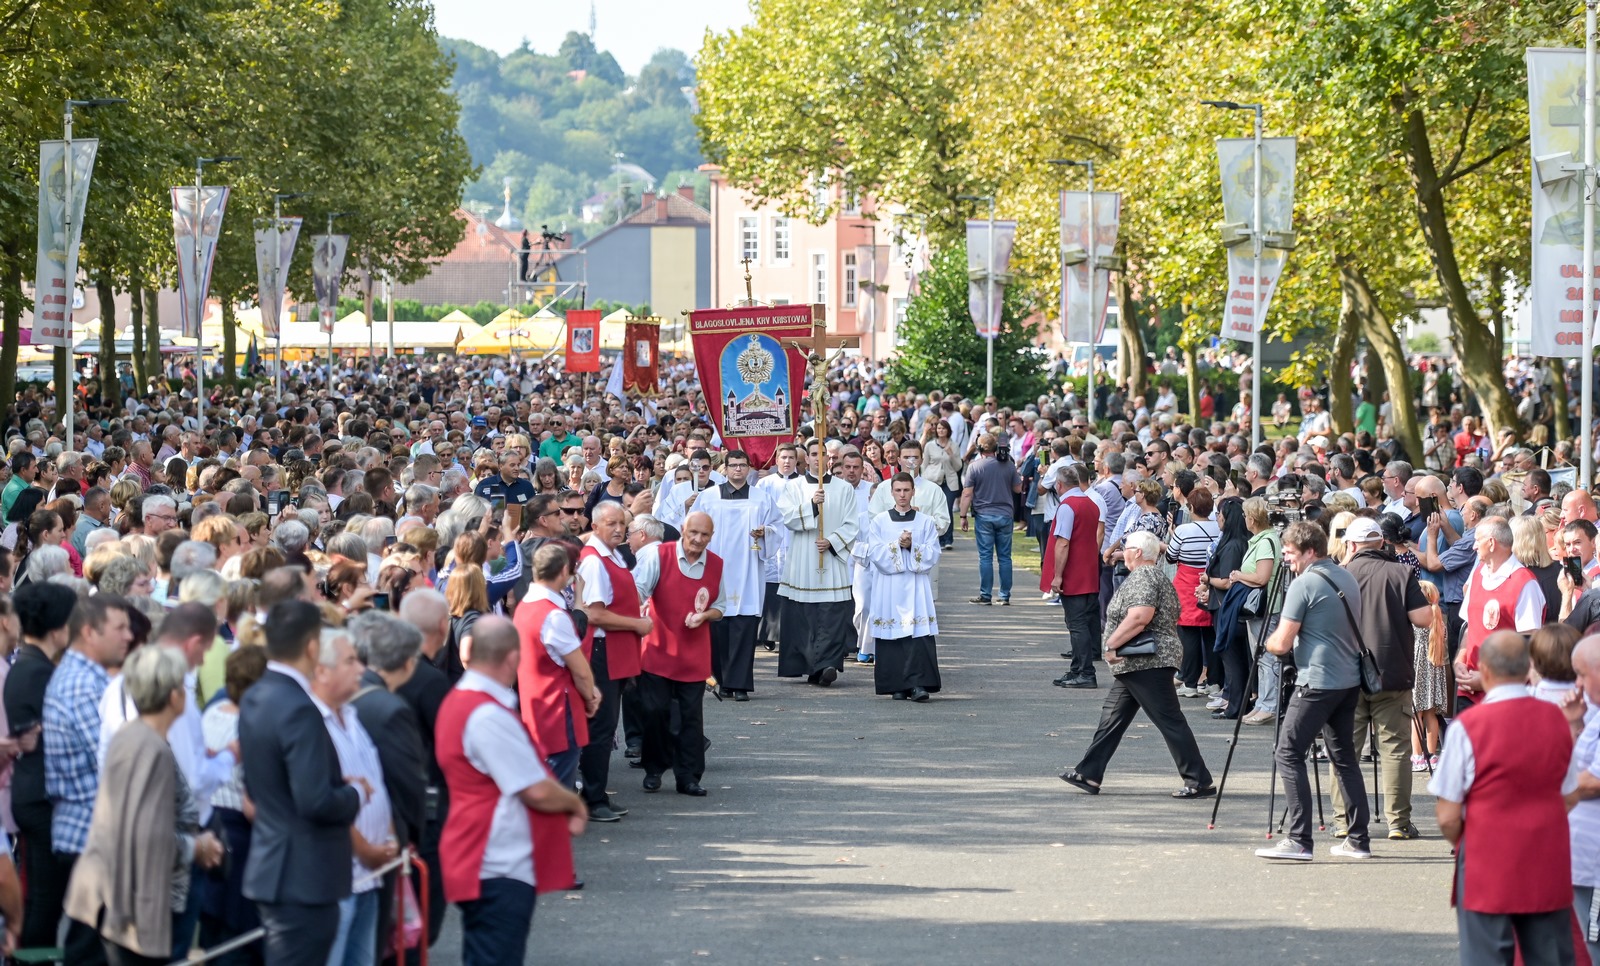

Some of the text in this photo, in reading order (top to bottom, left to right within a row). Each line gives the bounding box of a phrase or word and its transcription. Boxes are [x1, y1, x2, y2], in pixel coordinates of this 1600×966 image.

[695, 317, 755, 329] BLAGOSLOVLJENA
[757, 316, 770, 325] KRV
[772, 315, 808, 324] KRISTOVA!
